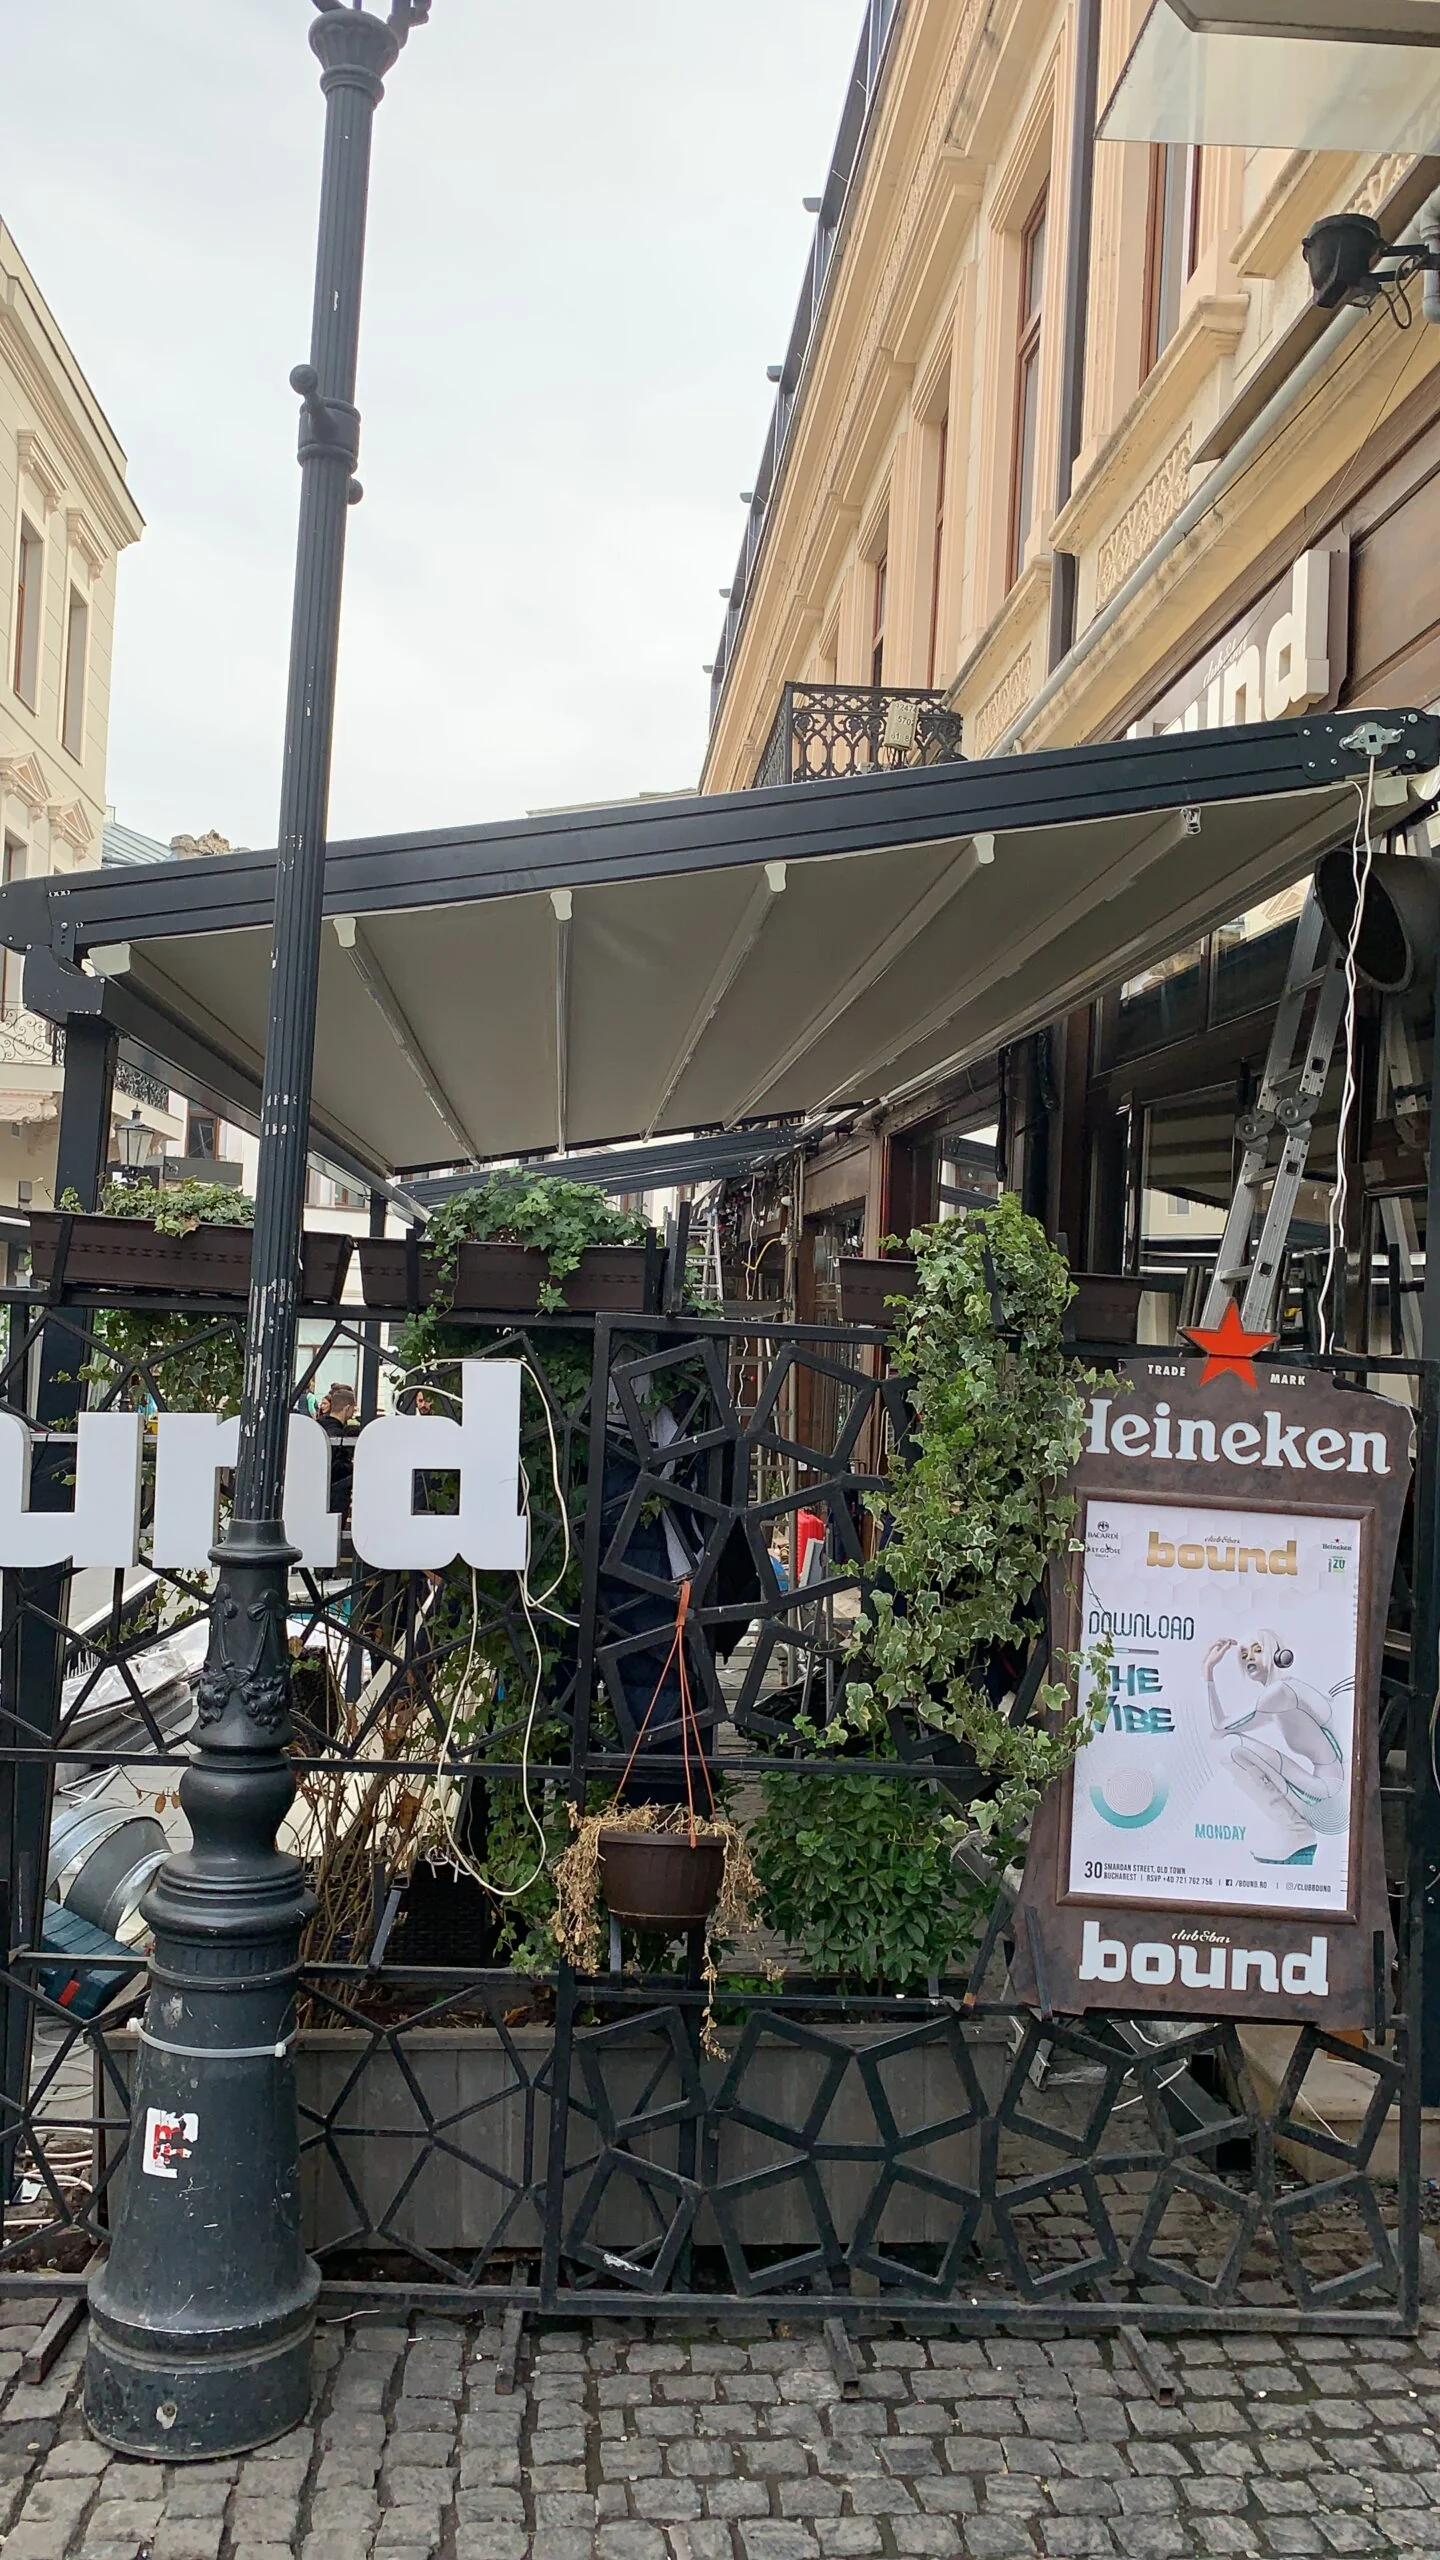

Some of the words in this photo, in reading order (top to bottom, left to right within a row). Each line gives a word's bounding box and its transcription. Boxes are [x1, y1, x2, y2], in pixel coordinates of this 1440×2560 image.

[1147, 1364, 1186, 1377] TRADE
[1270, 1373, 1305, 1386] MARK
[1146, 1531, 1298, 1576] bound
[1088, 1610, 1195, 1641] DOWNLOAD
[1194, 1823, 1247, 1841] MONDAY
[1084, 1861, 1103, 1879] 30
[1103, 1872, 1137, 1881] BUCHAREST
[1146, 1875, 1162, 1883] RSVP
[1133, 1865, 1156, 1874] STREET,
[1156, 1866, 1168, 1874] OLD
[1169, 1867, 1186, 1875] TOWN
[1078, 1920, 1329, 1996] bound
